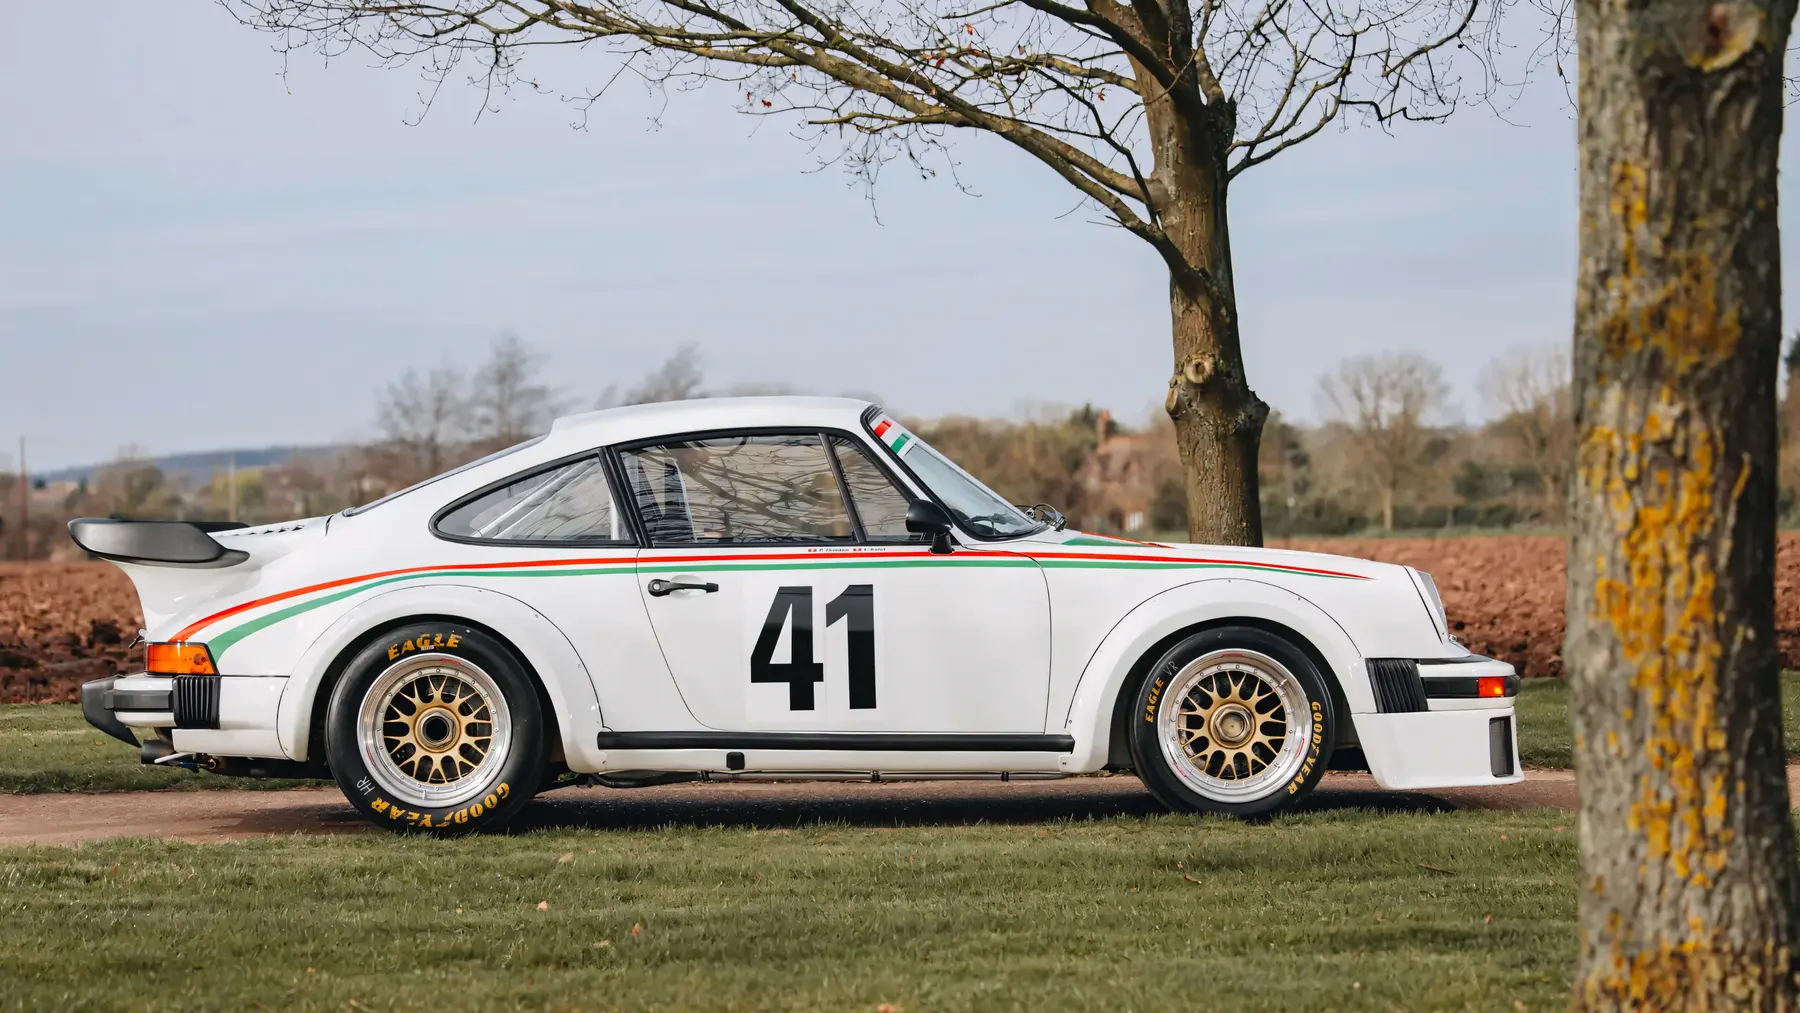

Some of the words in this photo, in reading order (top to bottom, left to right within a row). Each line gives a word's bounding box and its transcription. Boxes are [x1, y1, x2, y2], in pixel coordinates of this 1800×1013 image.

[387, 633, 463, 661] EAGLE
[750, 584, 877, 711] 41
[1145, 676, 1164, 723] EAGLE
[1287, 700, 1323, 795] GOODYEAR
[370, 782, 511, 828] GOODYEAR
